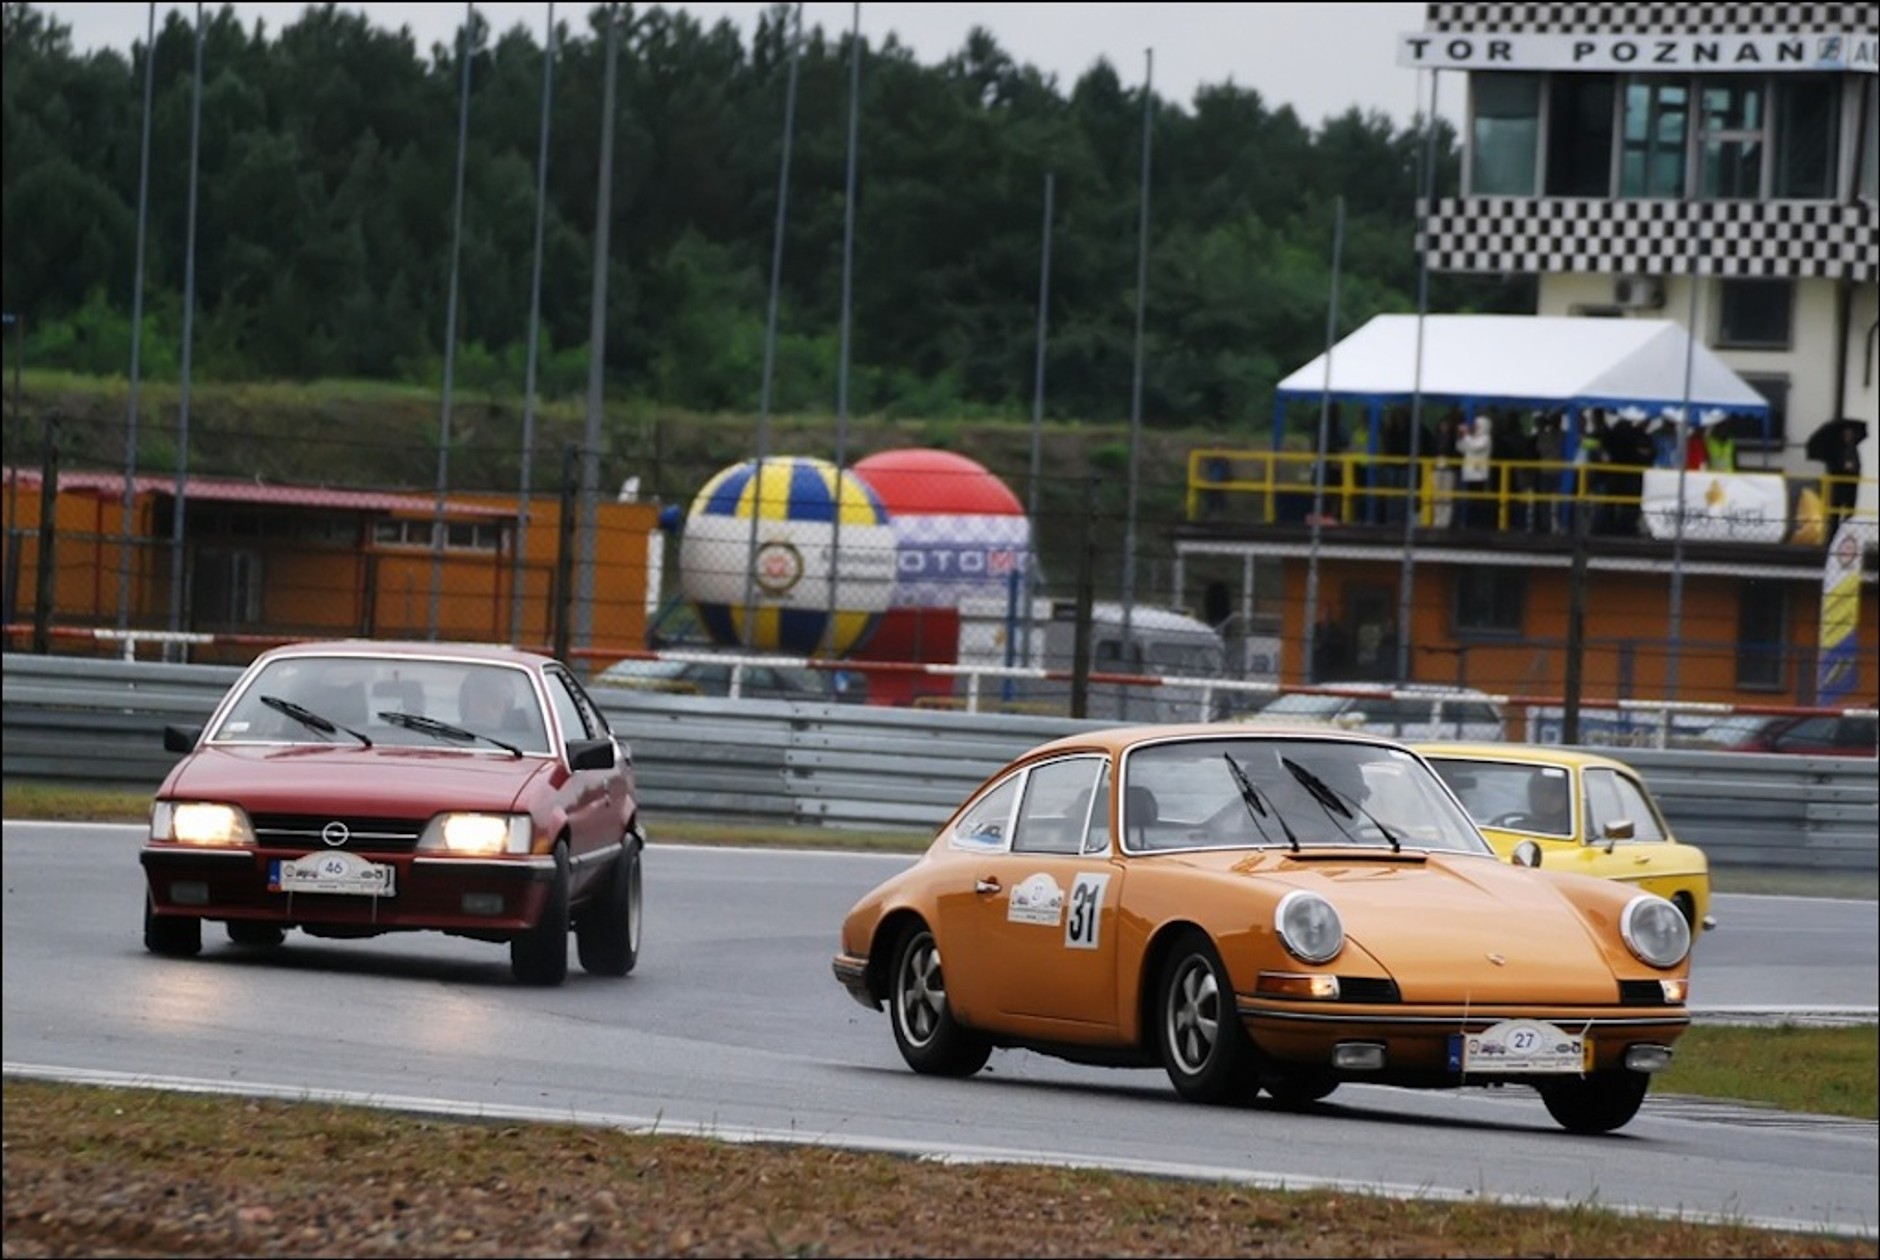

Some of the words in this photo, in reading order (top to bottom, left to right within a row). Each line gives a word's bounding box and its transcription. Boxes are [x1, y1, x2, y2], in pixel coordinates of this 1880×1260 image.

[1405, 39, 1514, 62] TOR
[1573, 37, 1806, 64] POZNAŃ
[325, 862, 343, 874] 46
[1069, 882, 1100, 943] 31
[1514, 1033, 1535, 1049] 27
